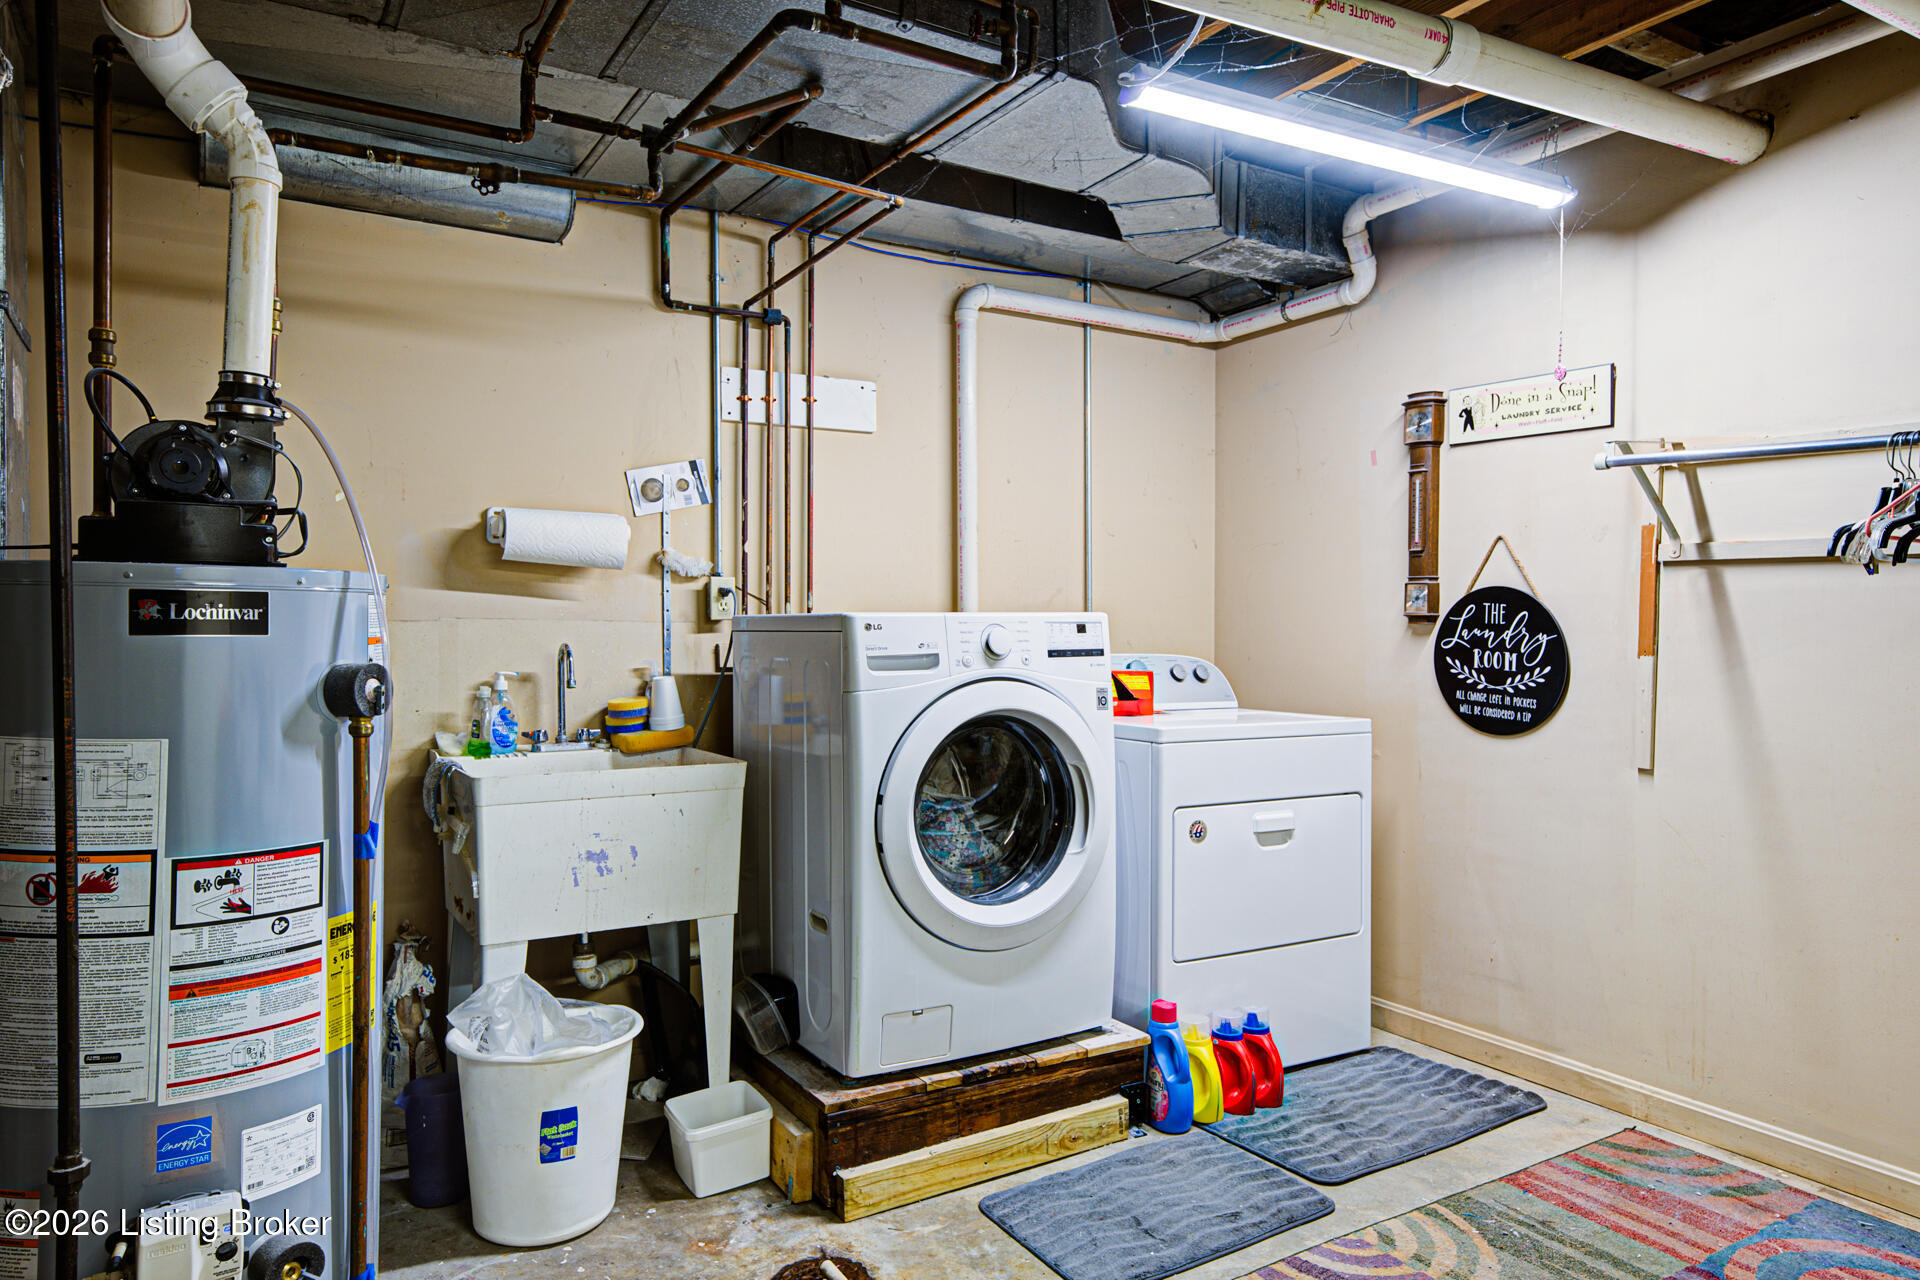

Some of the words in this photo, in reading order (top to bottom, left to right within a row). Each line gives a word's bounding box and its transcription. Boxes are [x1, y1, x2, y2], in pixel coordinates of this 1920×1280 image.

[1327, 0, 1345, 14] PIPE
[1349, 4, 1396, 29] CHARLOTTE
[1491, 392, 1522, 413] Done
[1528, 393, 1539, 403] in
[1545, 393, 1552, 401] a
[1558, 374, 1597, 403] Snap!
[1501, 408, 1540, 420] LAUNDRY
[1545, 403, 1582, 415] SERVICE
[168, 603, 263, 621] Lochinvar
[1483, 602, 1507, 625] THE
[1441, 604, 1557, 667] Laundry
[1473, 648, 1518, 672] ROOM
[1456, 690, 1465, 700] ALL
[1459, 703, 1472, 714] WILL
[1517, 711, 1521, 721] A
[244, 855, 275, 864] DANGER
[229, 887, 244, 895] HOT
[330, 923, 354, 940] ENER
[158, 1159, 189, 1171] ENERGY
[190, 1154, 209, 1165] STAR
